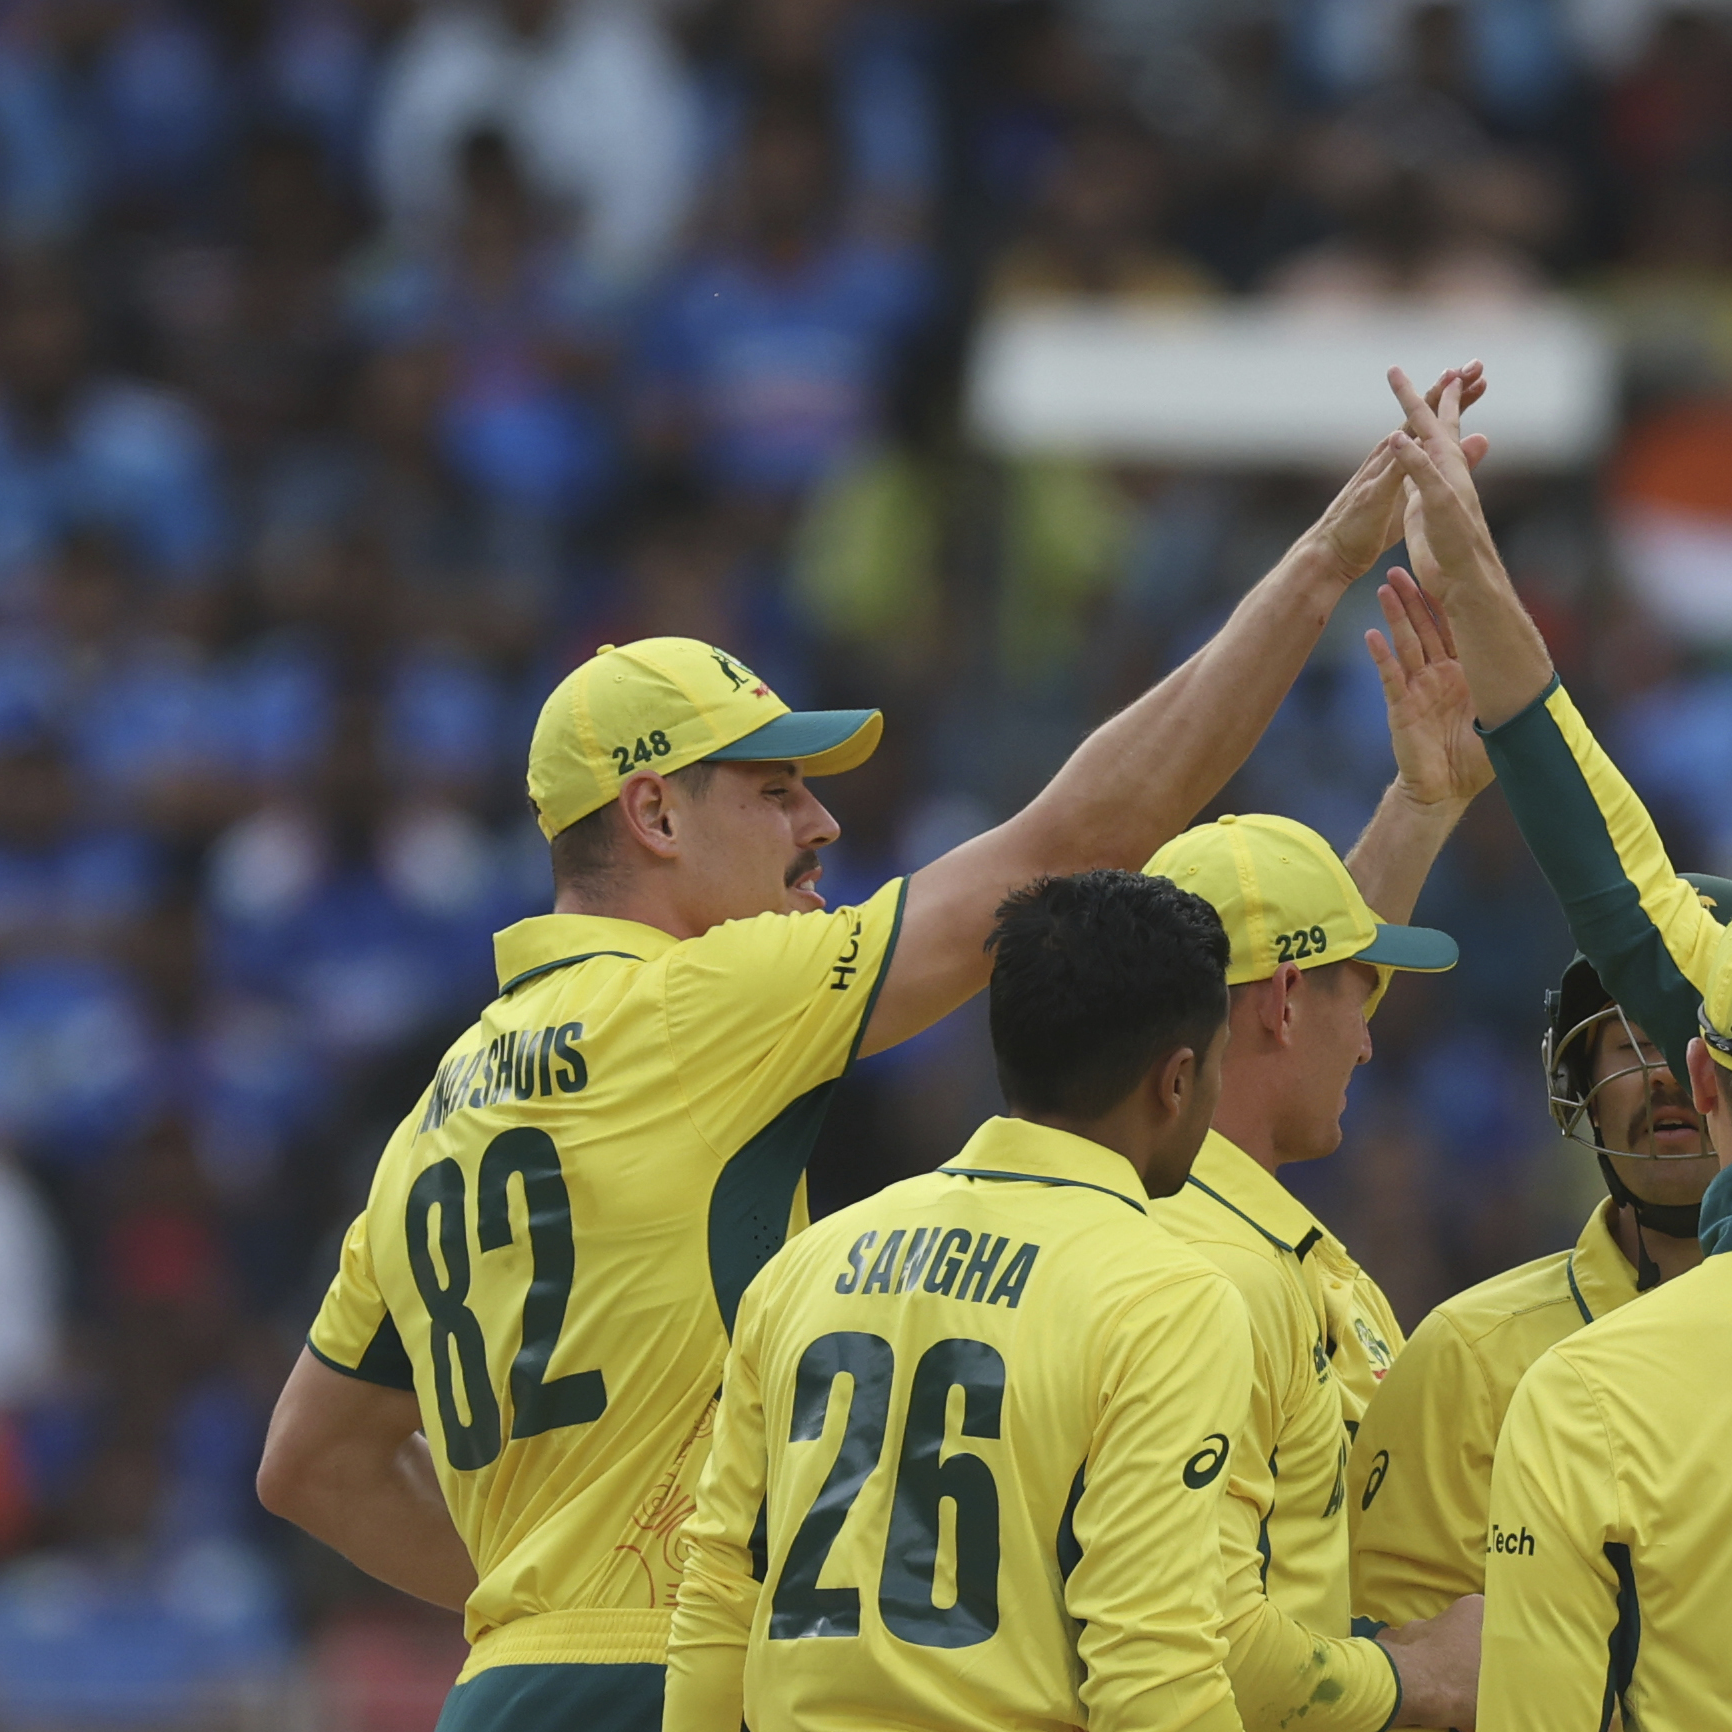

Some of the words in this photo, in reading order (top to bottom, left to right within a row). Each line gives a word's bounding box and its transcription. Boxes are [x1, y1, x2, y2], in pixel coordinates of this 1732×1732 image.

[612, 729, 672, 776] 248
[1275, 925, 1327, 964] 229
[405, 1126, 608, 1471] 82
[835, 1226, 1040, 1309] SANGHA
[768, 1331, 1006, 1649] 26
